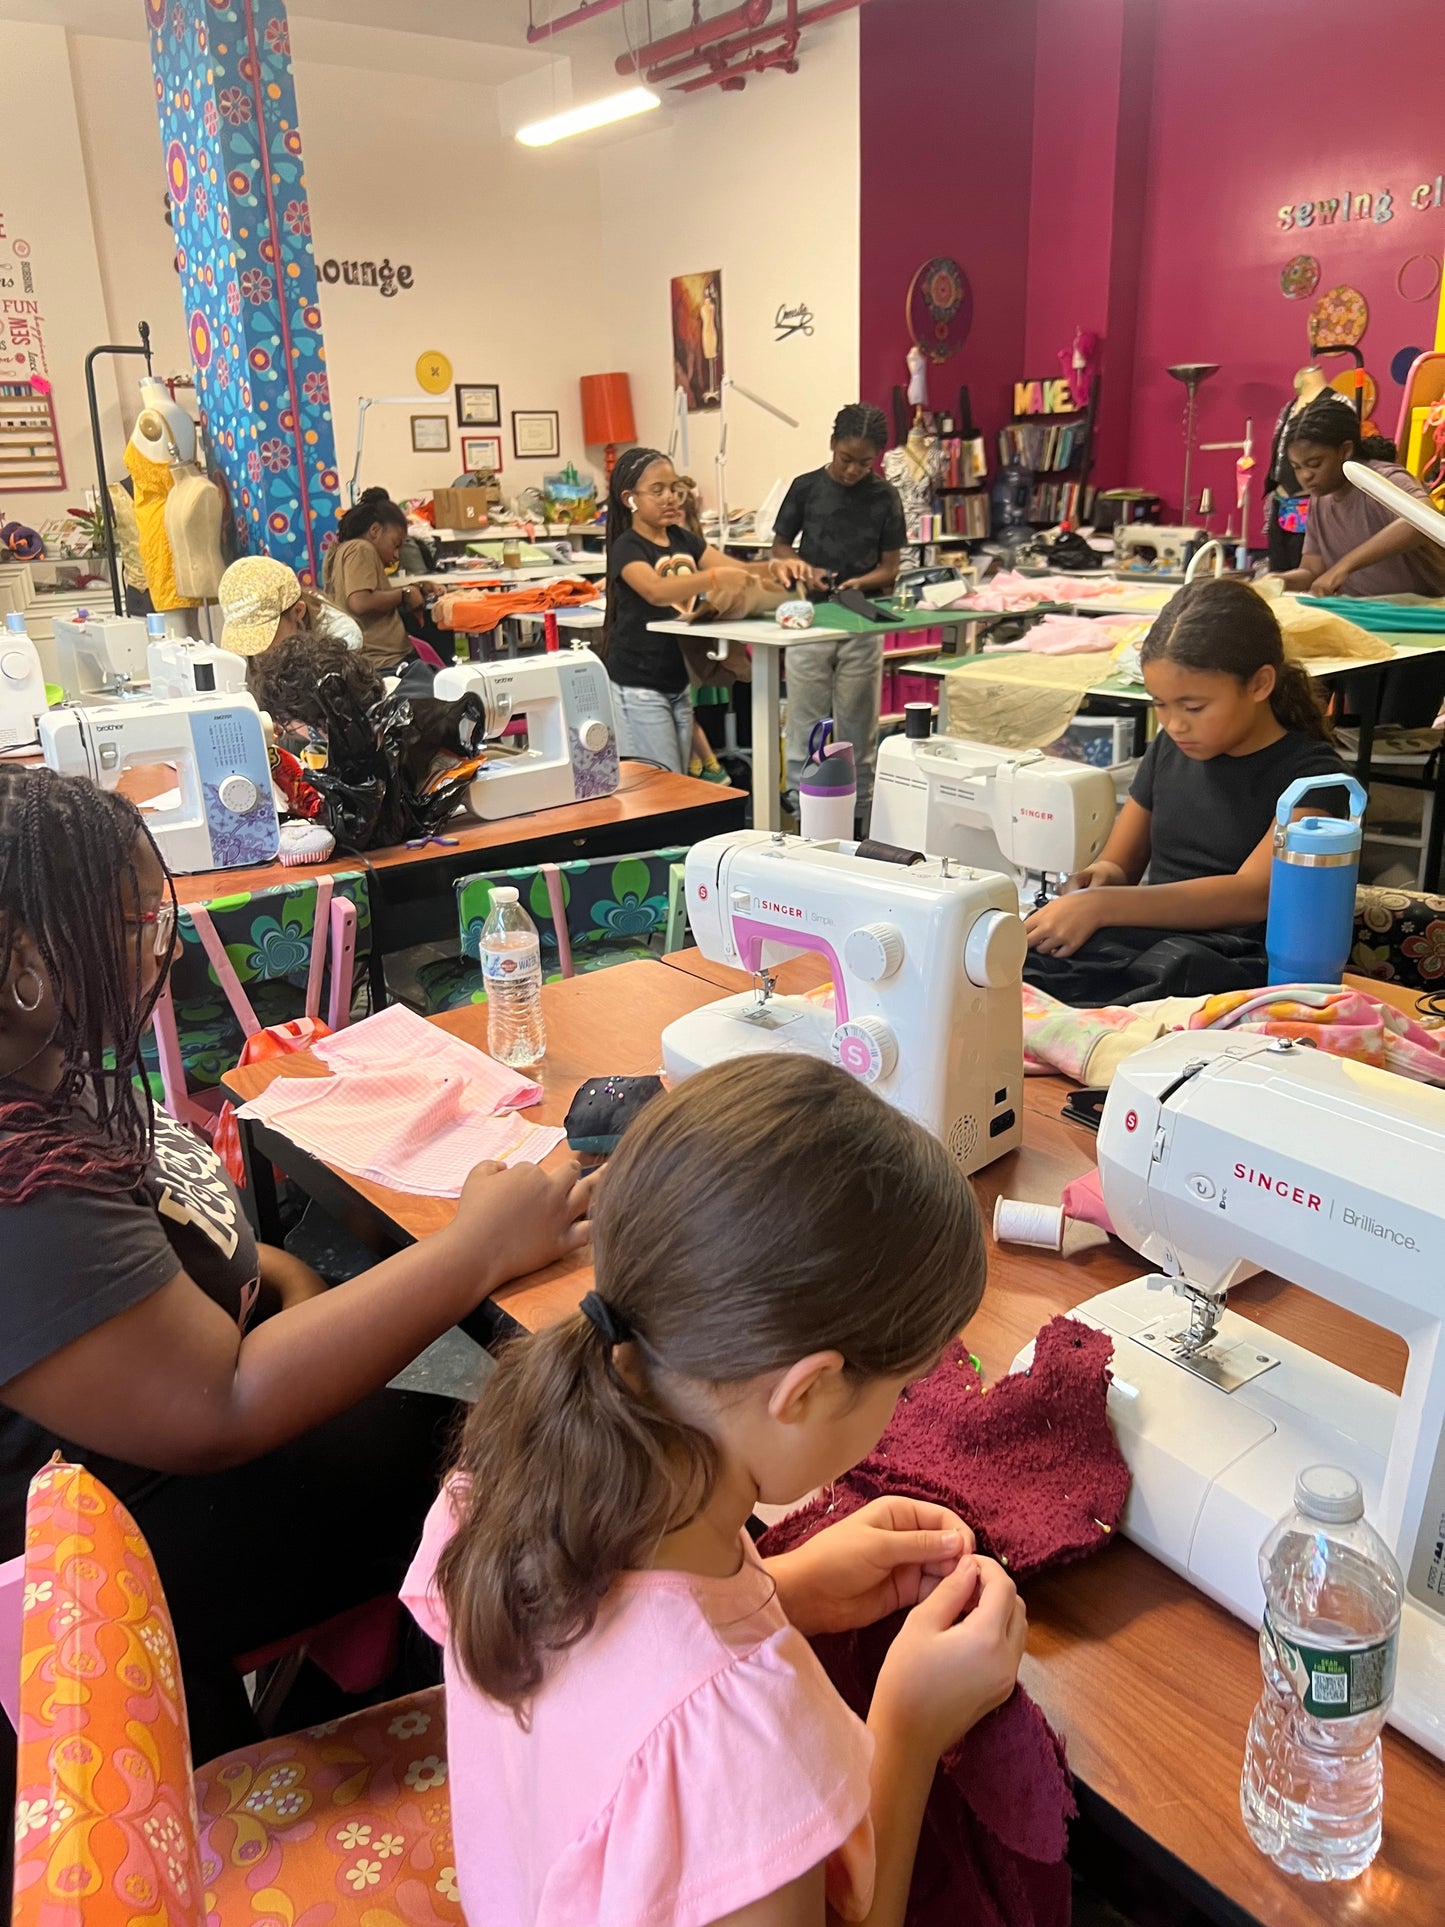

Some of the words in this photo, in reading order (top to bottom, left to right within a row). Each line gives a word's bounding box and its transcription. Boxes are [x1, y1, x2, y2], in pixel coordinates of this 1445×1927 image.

[1276, 188, 1394, 231] sewing
[315, 258, 415, 298] ounge
[2, 300, 38, 314] FUN
[8, 317, 31, 346] SEW
[96, 723, 124, 733] brother
[1020, 808, 1054, 821] SINGER
[761, 900, 803, 919] SINGER
[1233, 1162, 1323, 1213] SINGER
